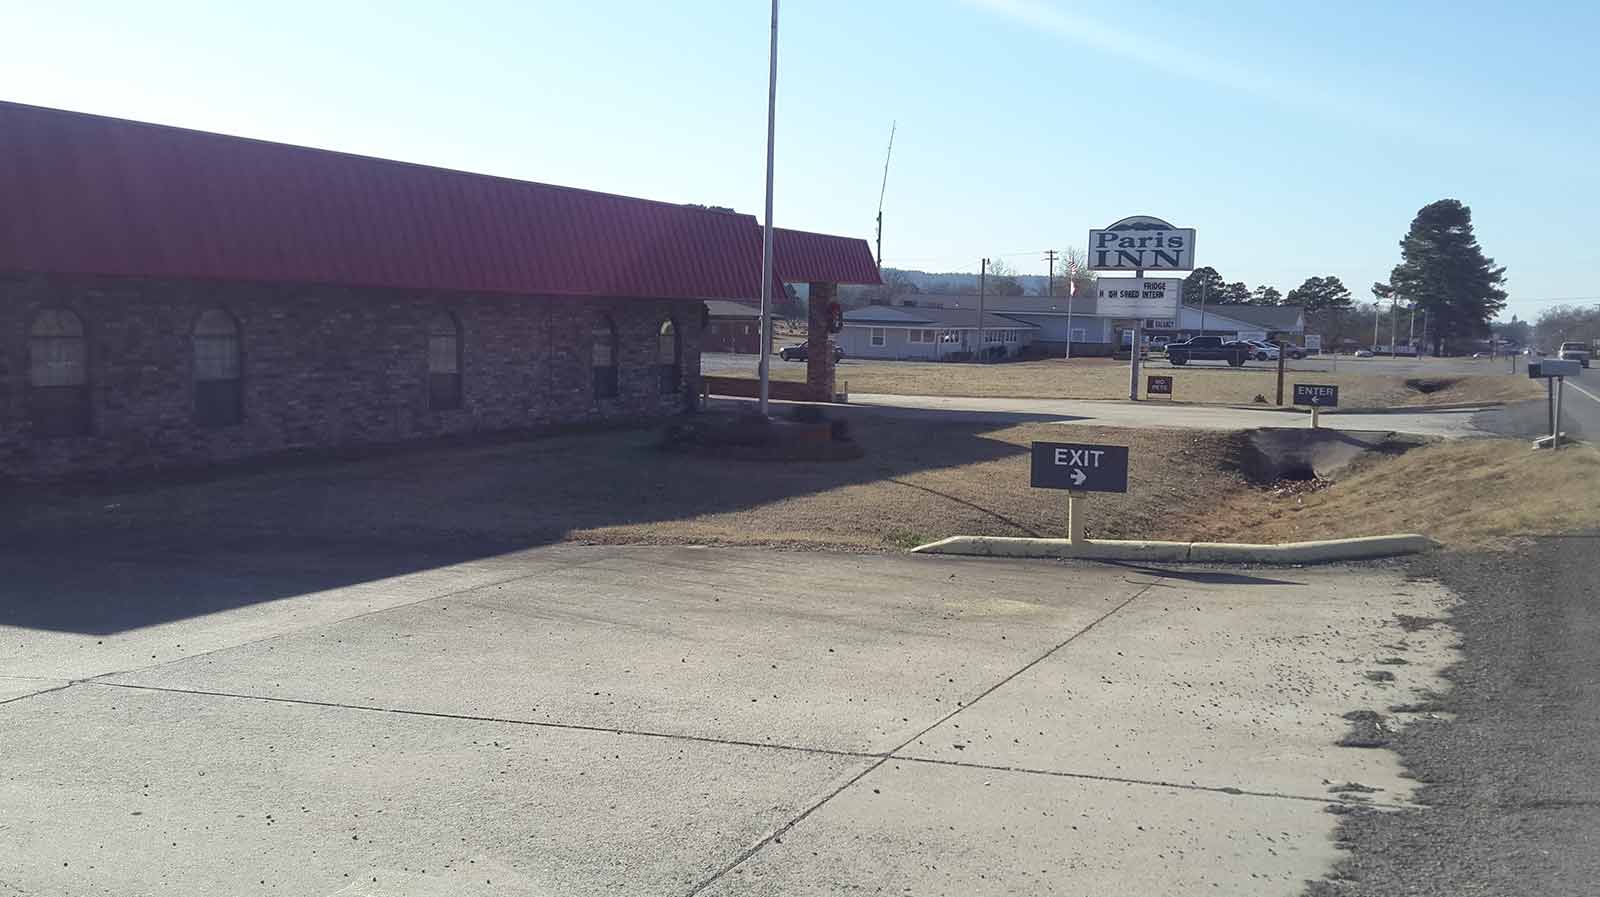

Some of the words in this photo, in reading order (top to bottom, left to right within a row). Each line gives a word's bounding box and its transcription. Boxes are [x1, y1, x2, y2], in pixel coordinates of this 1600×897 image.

[1096, 232, 1184, 248] Paris
[1095, 249, 1184, 267] INN
[1144, 282, 1166, 290] FRIDGE
[1119, 290, 1140, 298] SPEED
[1298, 386, 1334, 396] ENTER
[1055, 448, 1104, 467] EXIT
